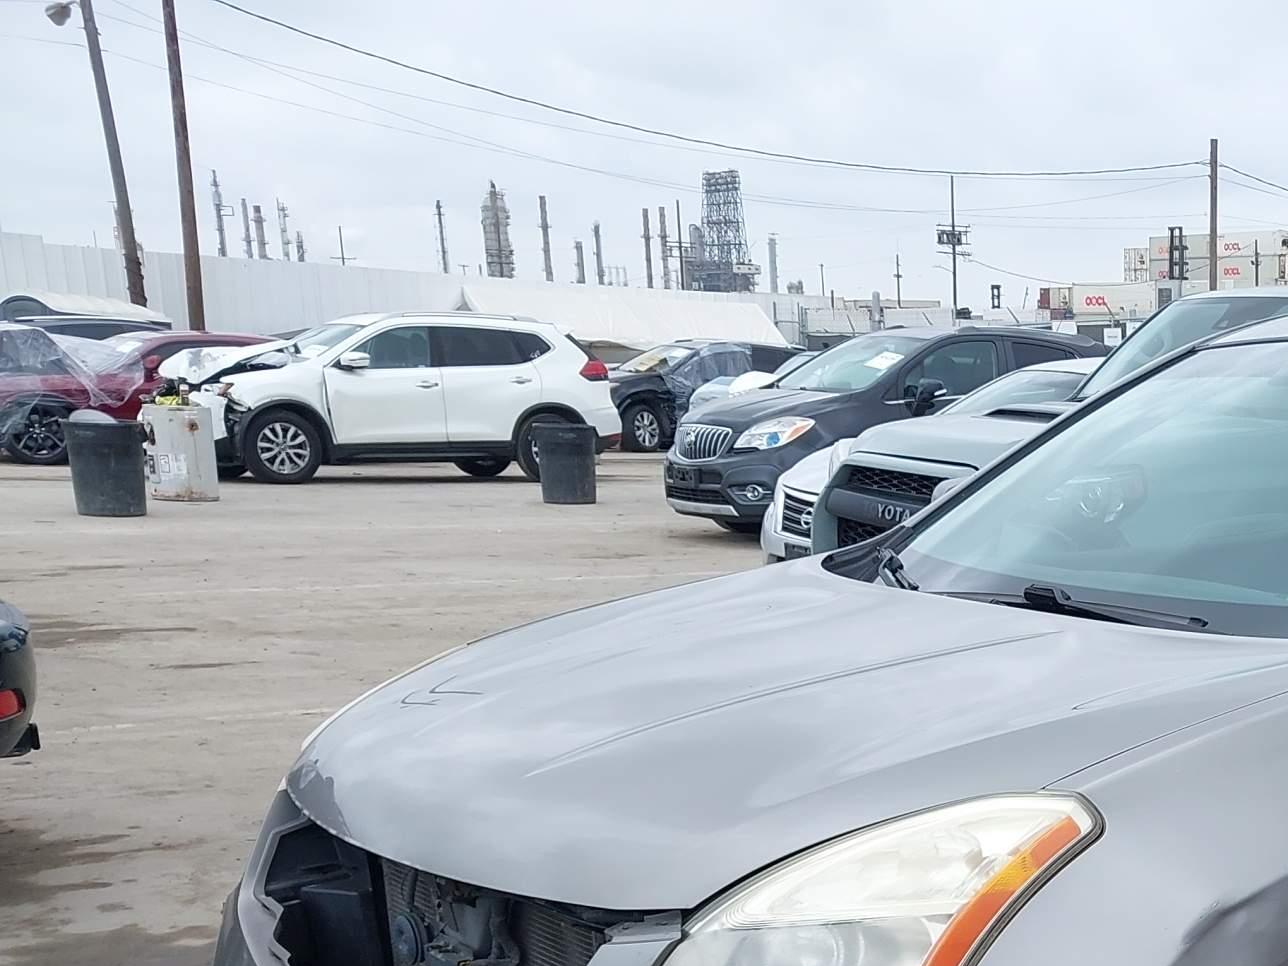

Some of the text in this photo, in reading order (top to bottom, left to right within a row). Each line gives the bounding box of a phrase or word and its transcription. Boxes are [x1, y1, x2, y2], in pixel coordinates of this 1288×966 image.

[1224, 243, 1241, 251] OOCL
[1224, 268, 1240, 276] OOCL
[1085, 296, 1105, 306] OOCL
